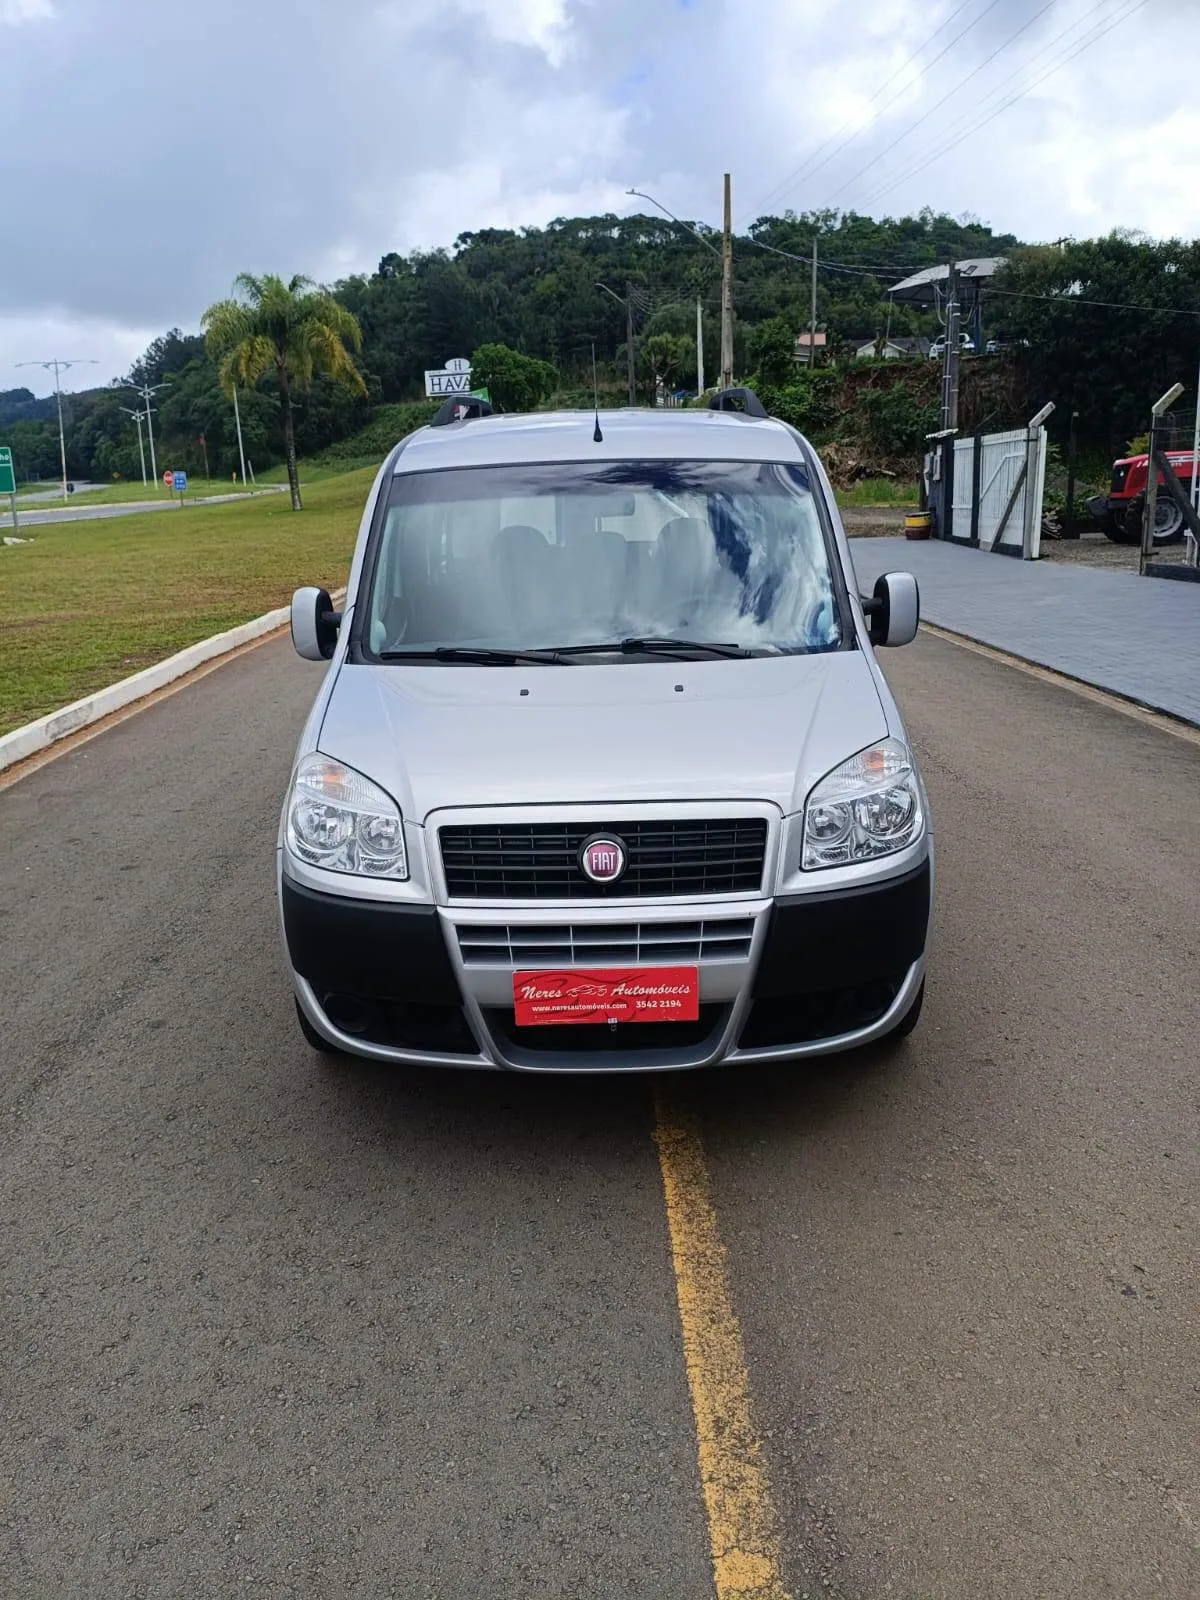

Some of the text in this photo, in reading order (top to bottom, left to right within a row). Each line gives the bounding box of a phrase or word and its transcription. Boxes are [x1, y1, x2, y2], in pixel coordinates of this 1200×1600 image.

[454, 360, 462, 370] H
[431, 376, 470, 391] HAVA
[592, 852, 616, 870] FIAT
[521, 983, 691, 999] Neres Automóveis
[659, 1000, 682, 1008] 2194
